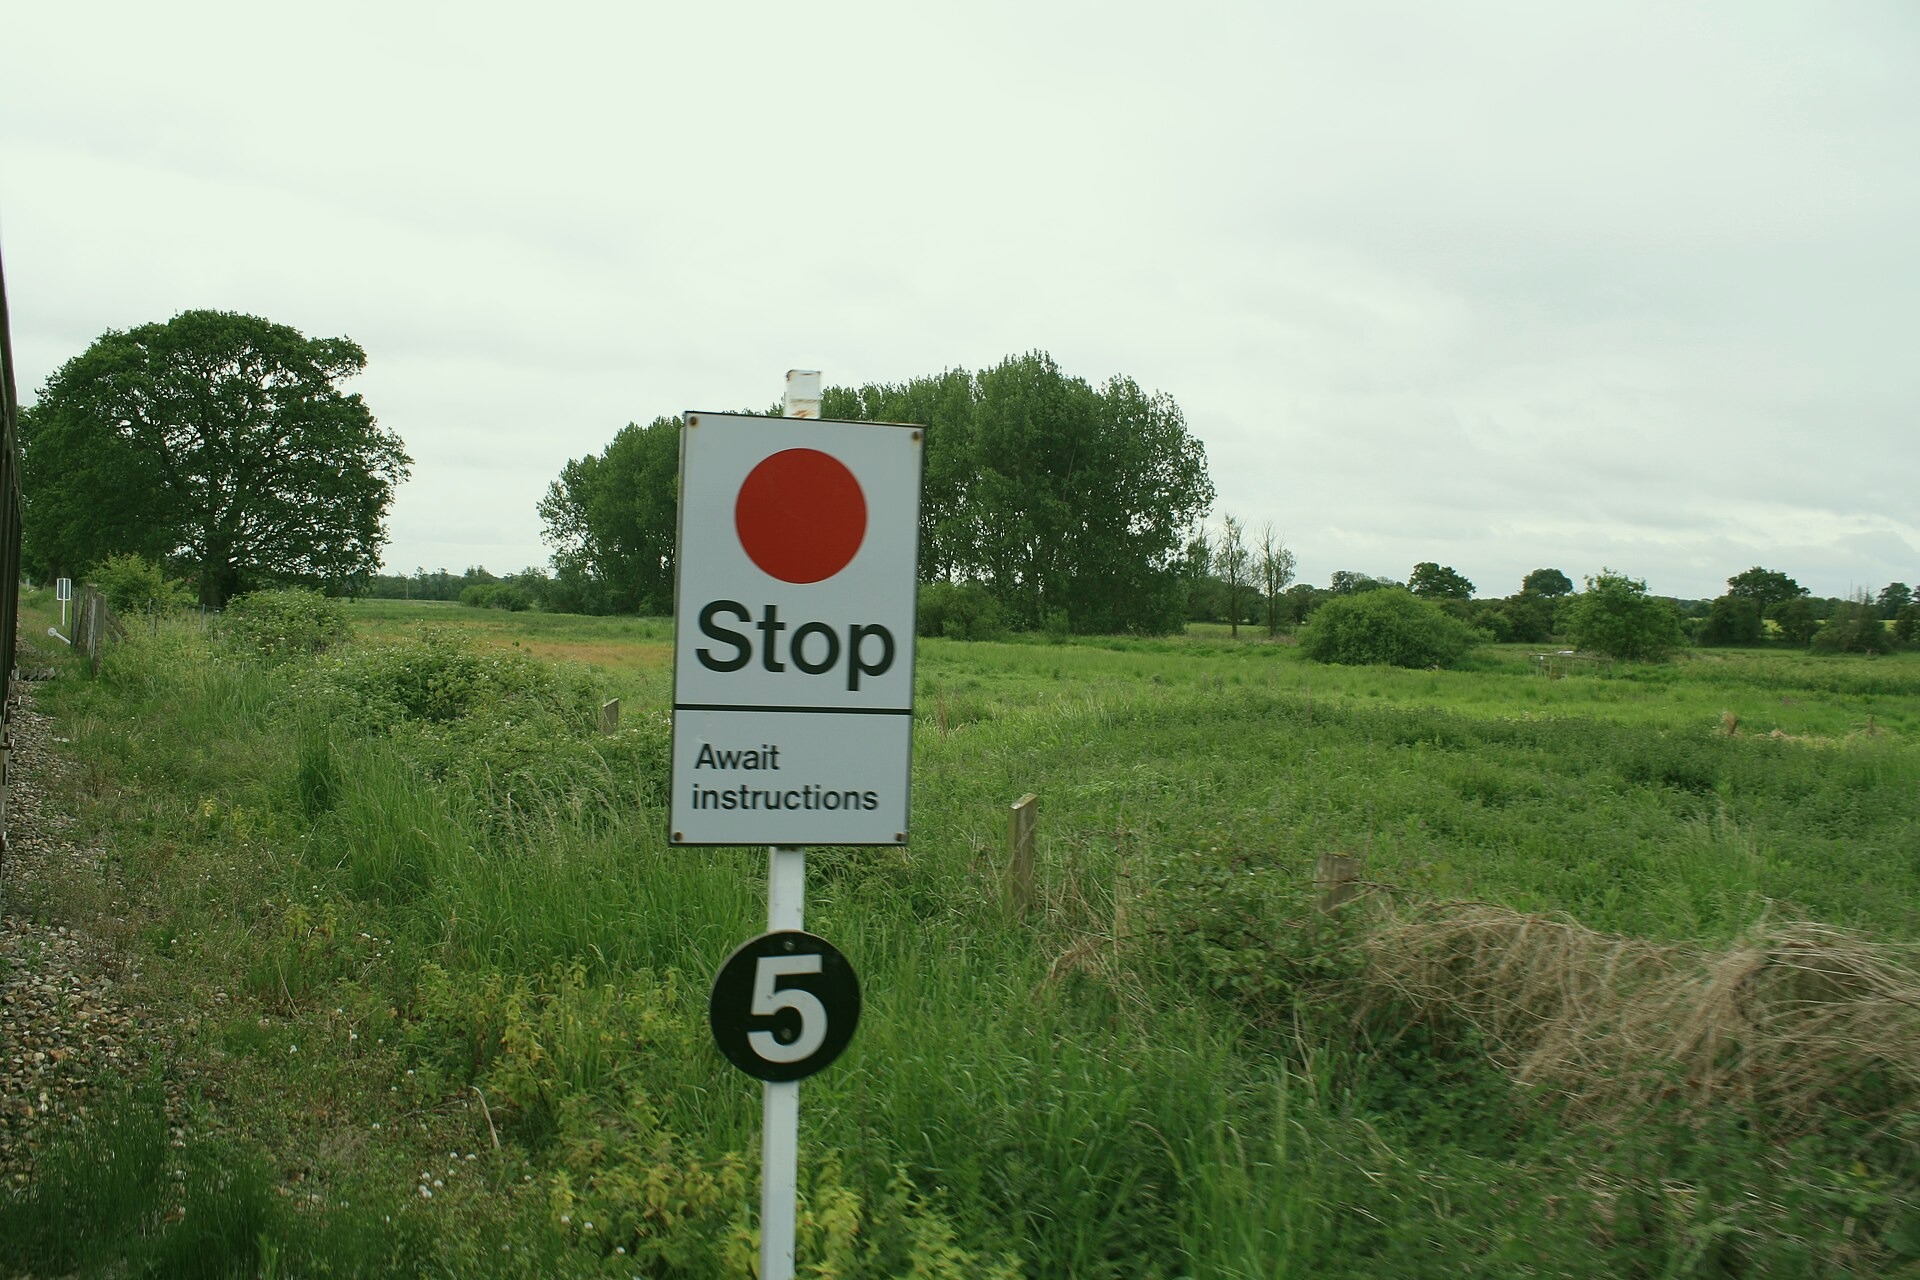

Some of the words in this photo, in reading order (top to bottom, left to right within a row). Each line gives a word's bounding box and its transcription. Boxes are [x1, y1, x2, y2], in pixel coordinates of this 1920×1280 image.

[695, 599, 897, 691] Stop
[694, 743, 781, 770] Await
[692, 783, 879, 811] instructions
[747, 953, 828, 1064] 5
